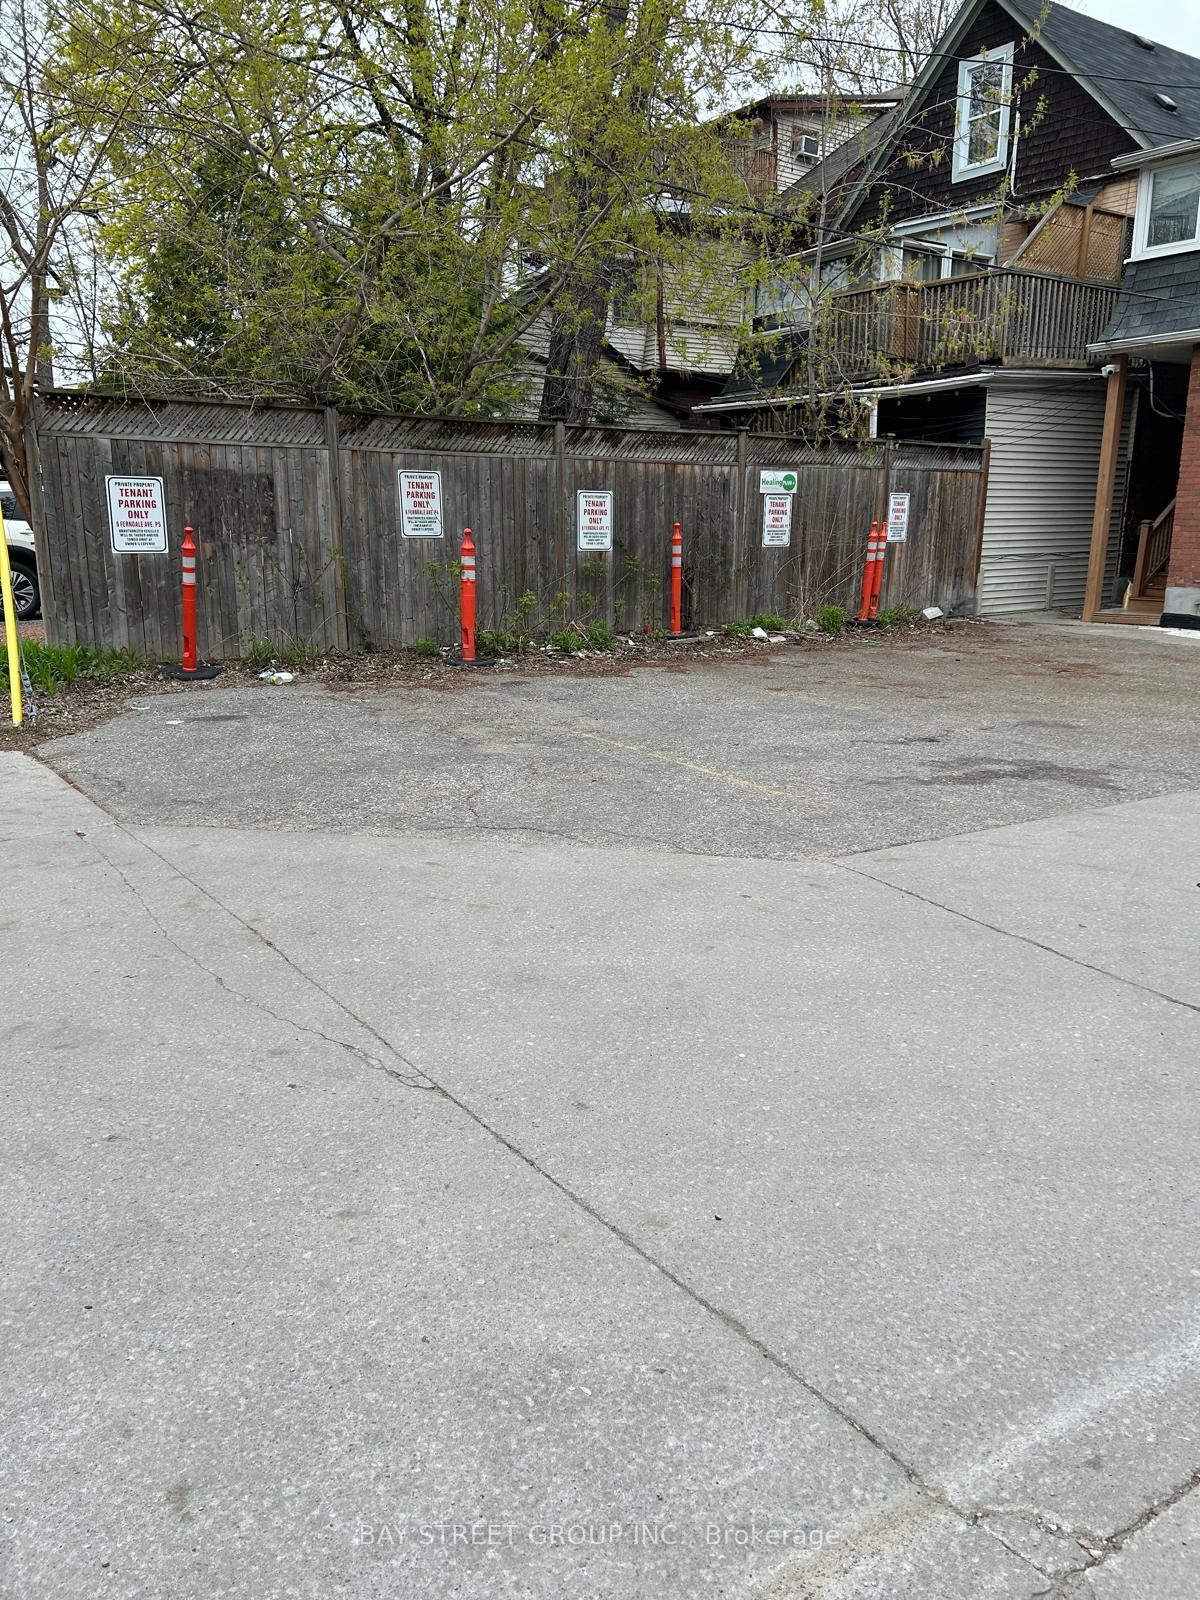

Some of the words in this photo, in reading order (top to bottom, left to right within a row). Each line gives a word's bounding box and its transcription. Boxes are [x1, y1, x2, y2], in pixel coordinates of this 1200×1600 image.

[408, 481, 433, 490] TENANT
[761, 478, 783, 487] Healing
[120, 488, 153, 497] TENANT
[407, 491, 436, 499] PARKING
[118, 500, 157, 508] PARKING
[413, 500, 429, 508] ONLY
[128, 510, 149, 519] ONLY
